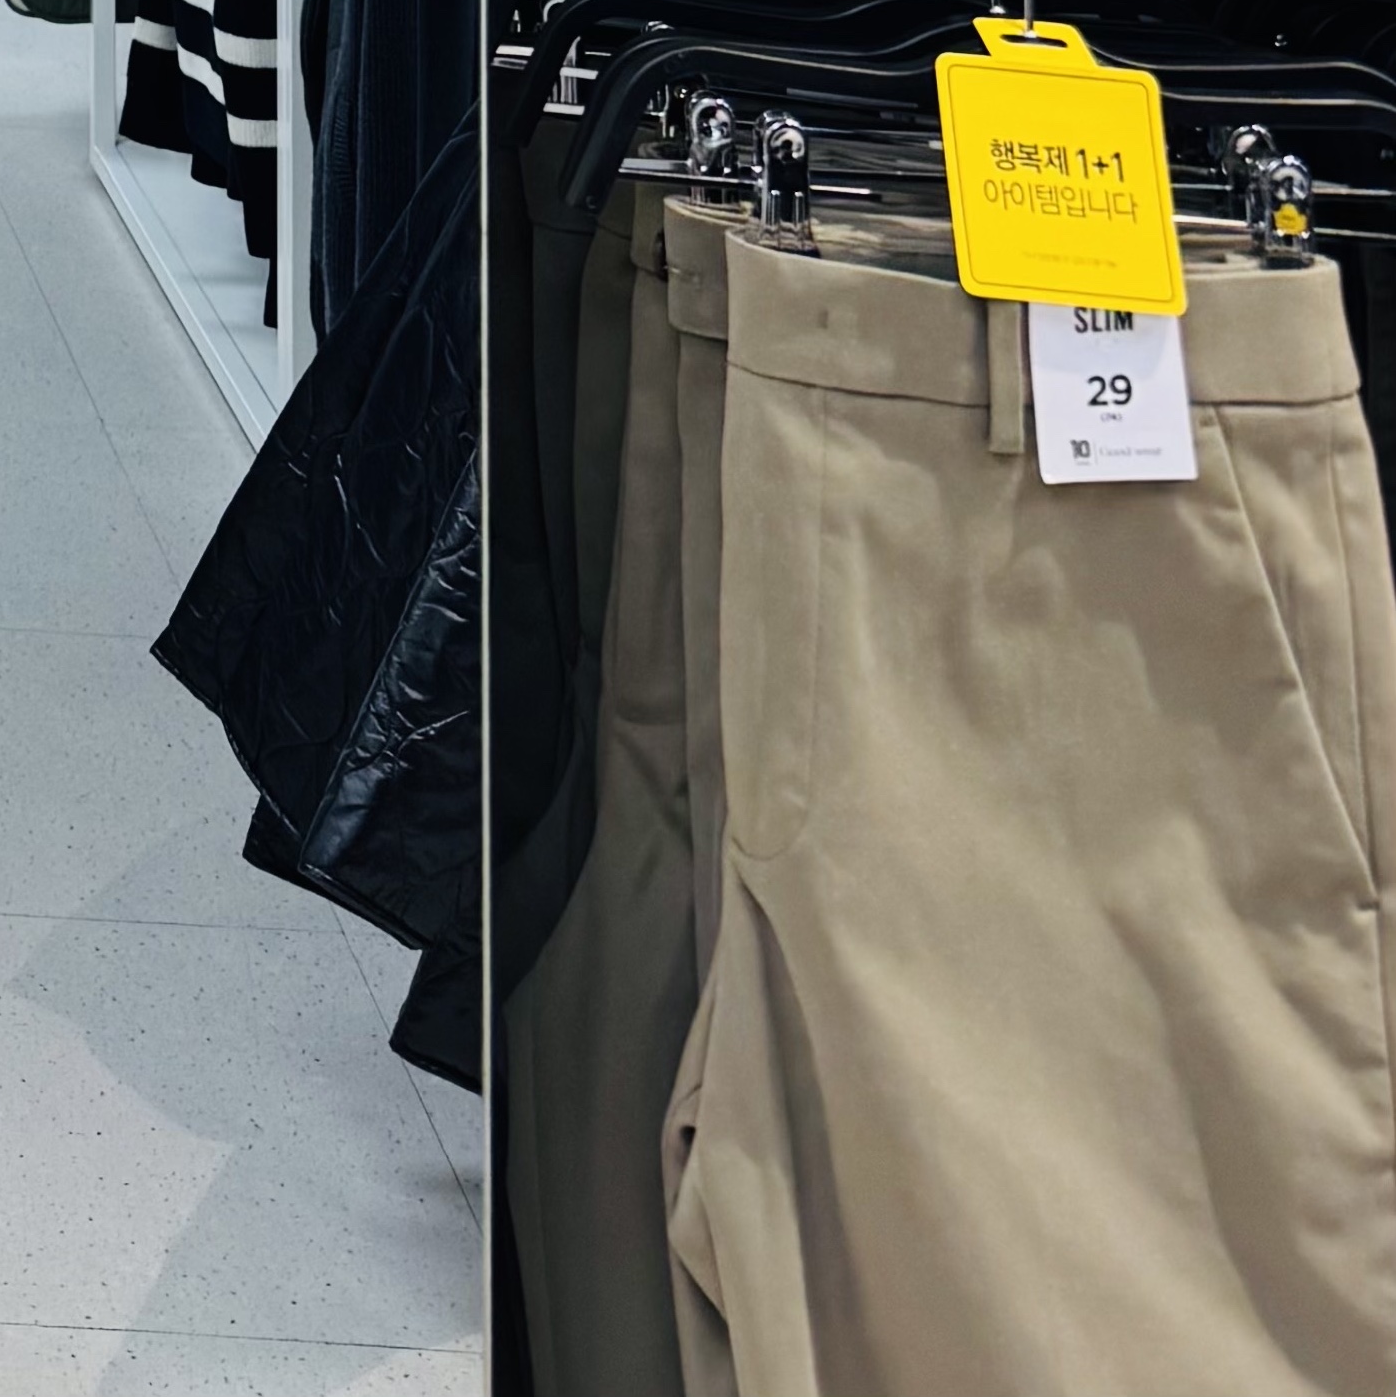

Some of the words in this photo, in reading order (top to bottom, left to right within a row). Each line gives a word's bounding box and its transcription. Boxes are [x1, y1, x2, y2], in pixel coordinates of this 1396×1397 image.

[989, 138, 1069, 177] 행복제
[1075, 147, 1126, 182] 1+1
[983, 179, 1139, 225] 아이템입니다
[1073, 307, 1133, 333] SLIM
[1087, 374, 1132, 406] 29
